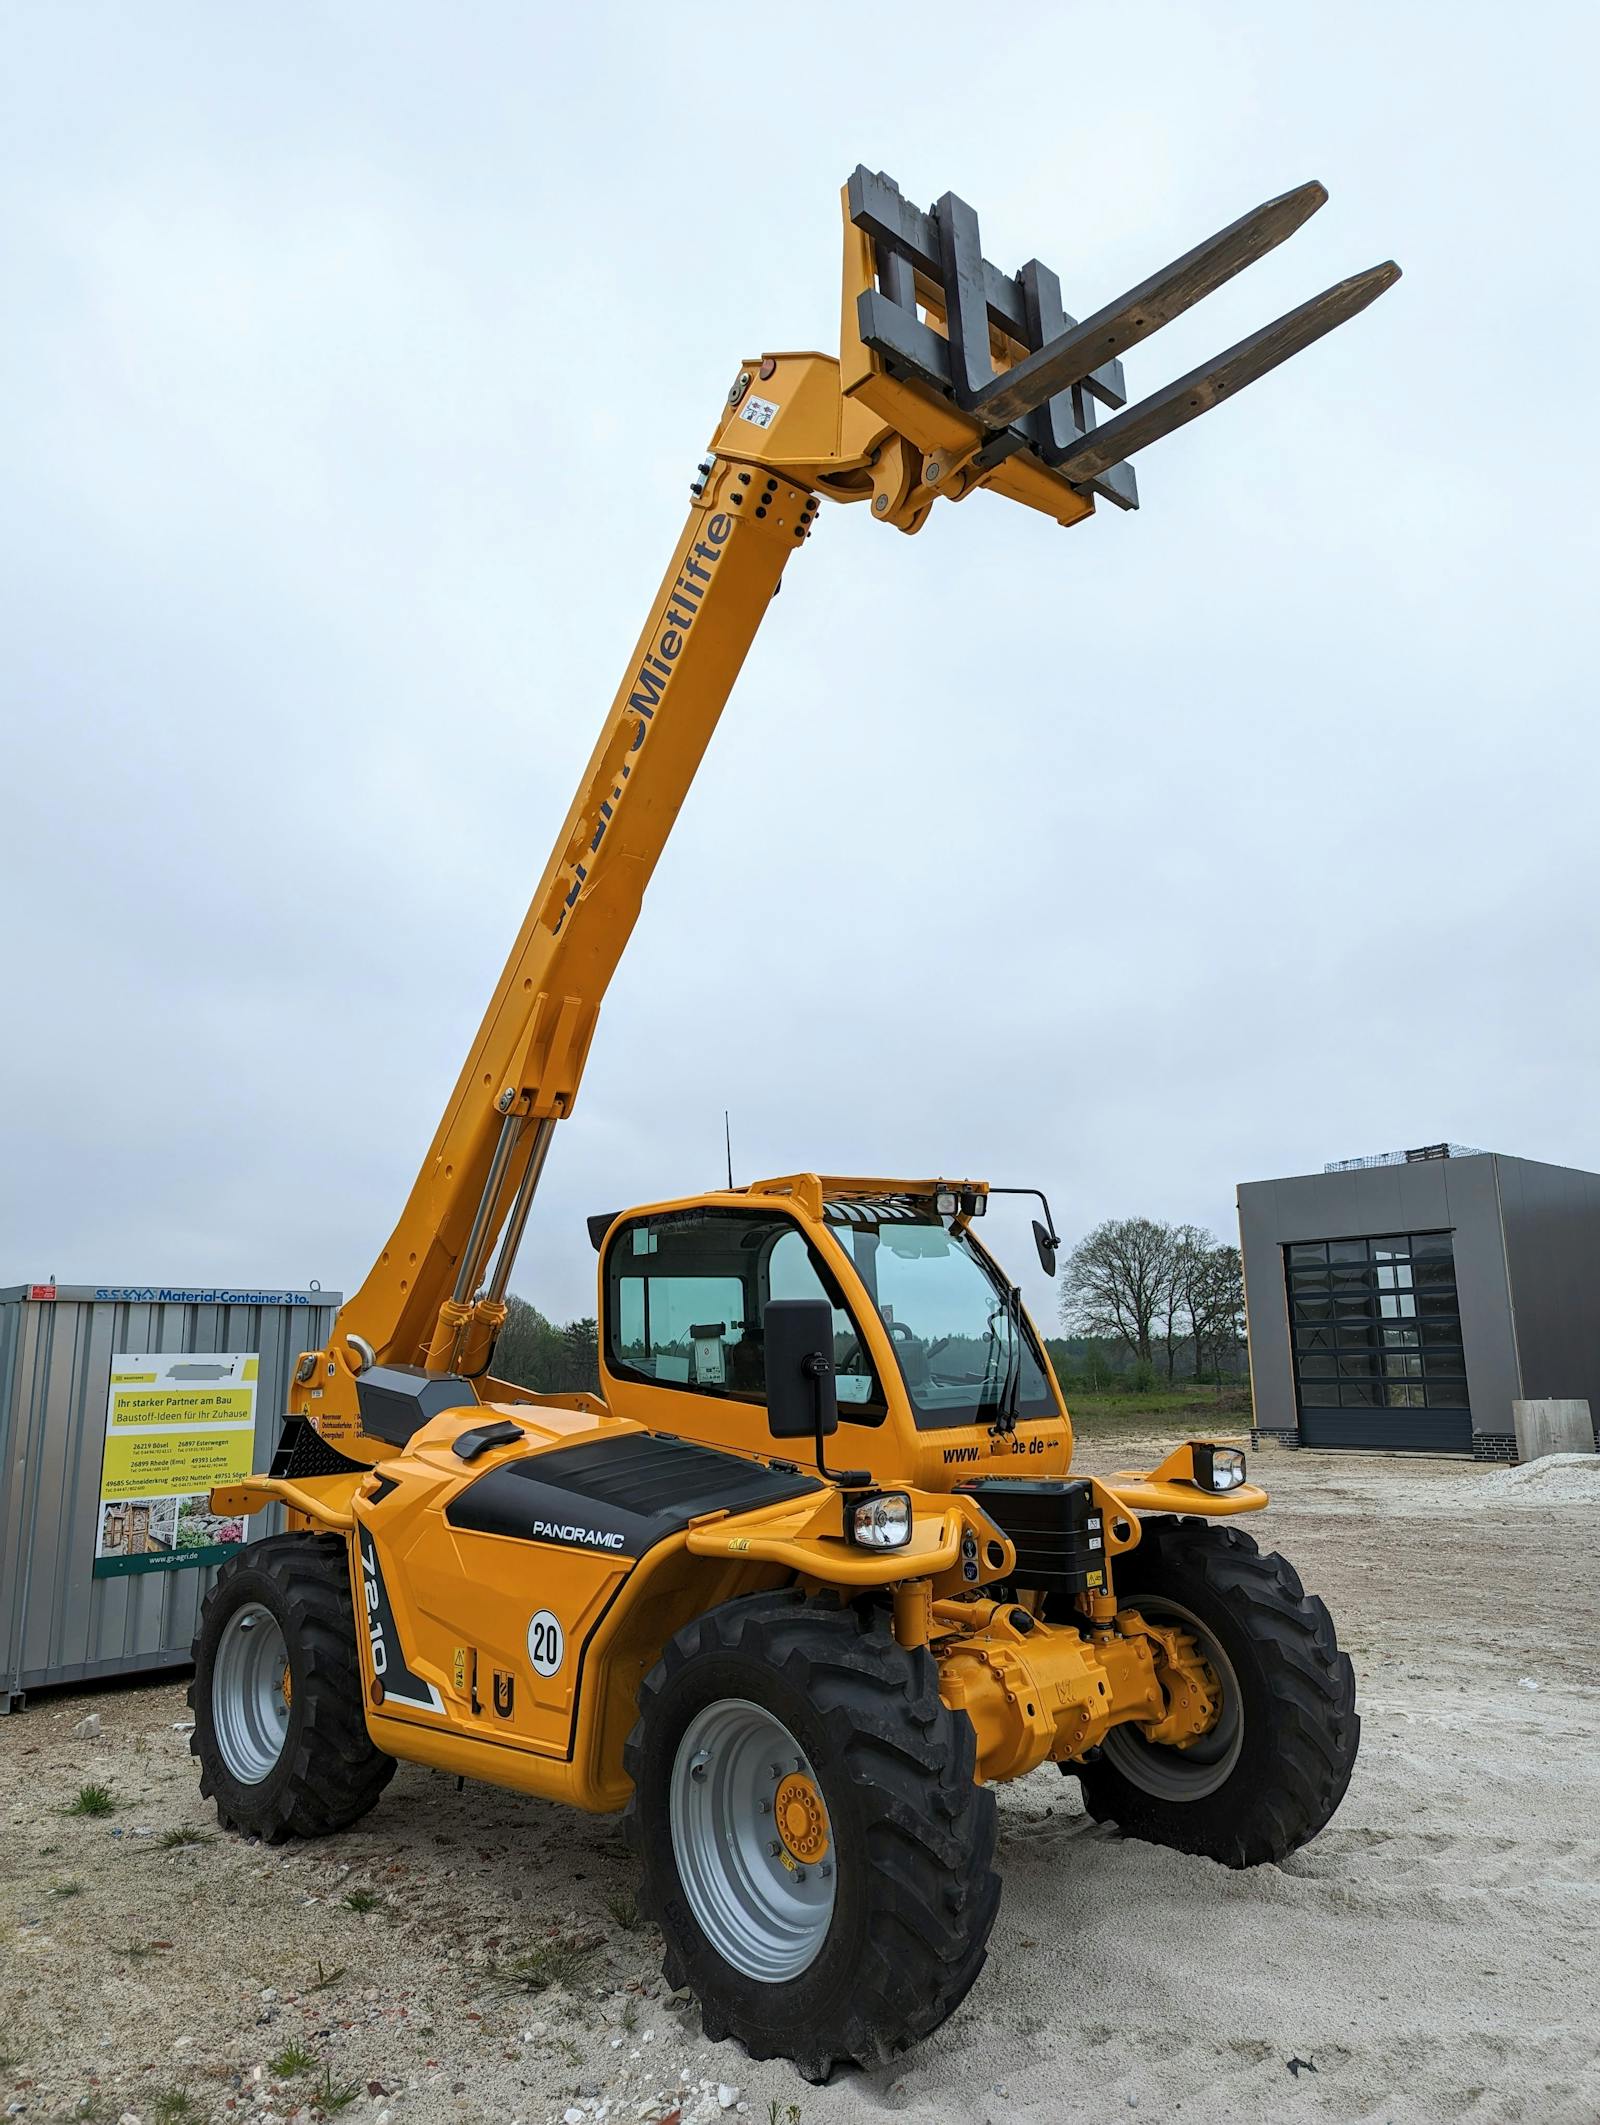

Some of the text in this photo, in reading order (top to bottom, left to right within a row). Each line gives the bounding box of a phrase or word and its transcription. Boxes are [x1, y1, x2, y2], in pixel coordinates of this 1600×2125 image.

[158, 1289, 283, 1304] Material-Container
[117, 1399, 130, 1408] Ihr
[132, 1398, 163, 1407] starker
[166, 1397, 198, 1406] Partner
[215, 1396, 232, 1405] Bau
[116, 1408, 248, 1422] Baustoff-Ideen für Ihr Zuhause
[532, 1520, 626, 1549] PANORAMIC
[148, 1552, 199, 1564] www.gs-agri.de
[361, 1543, 388, 1676] 72.10
[533, 1621, 557, 1665] 20
